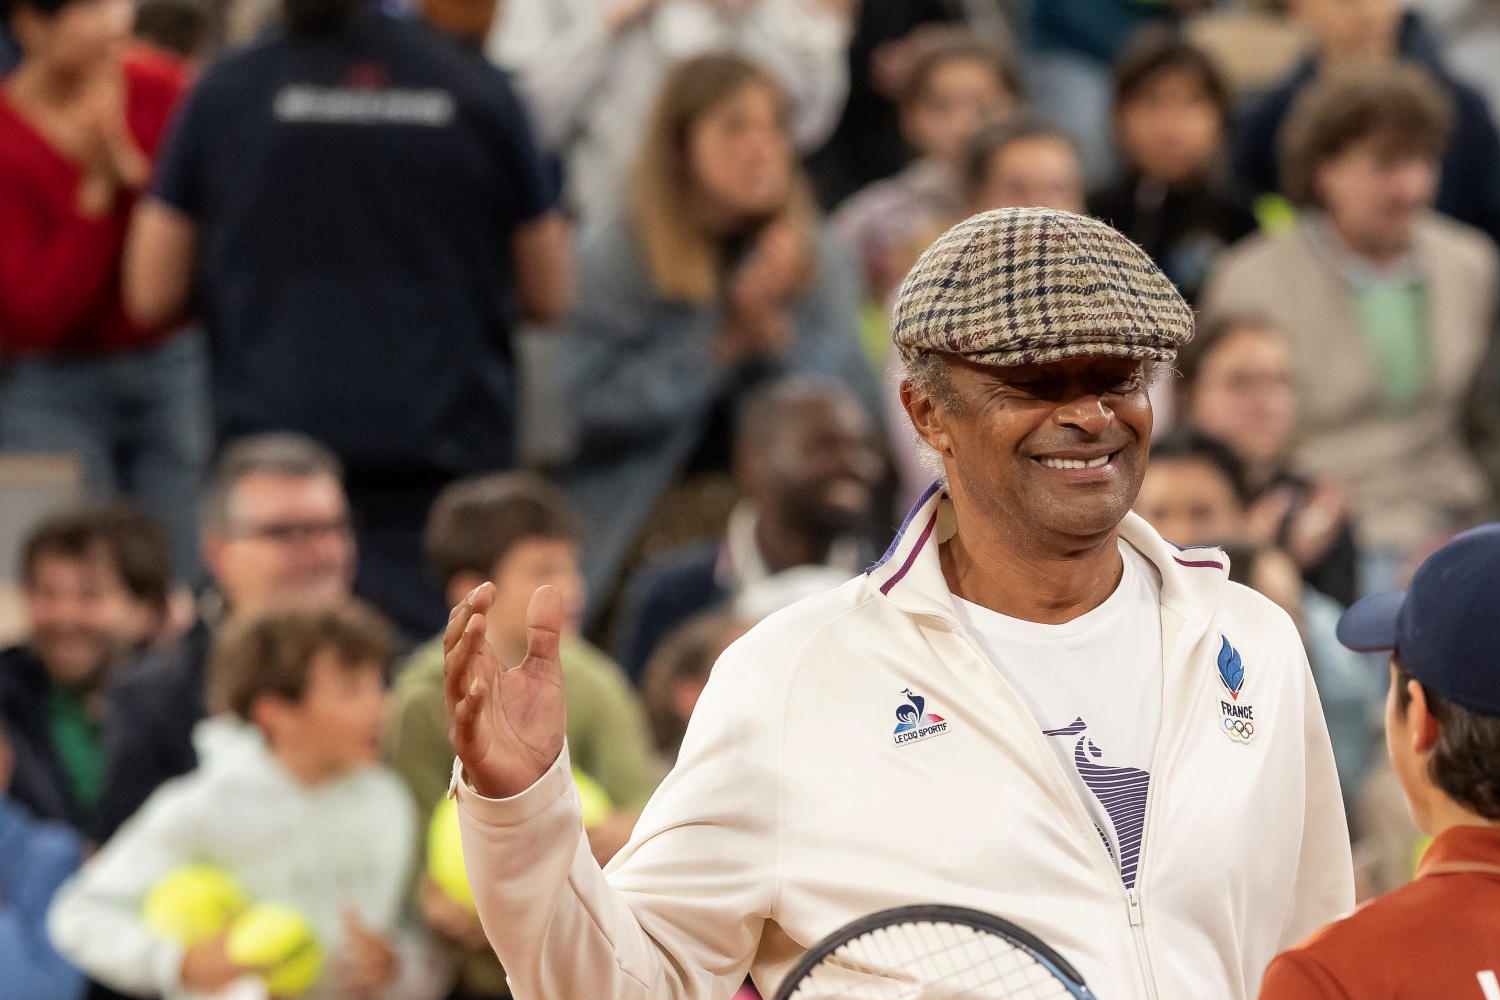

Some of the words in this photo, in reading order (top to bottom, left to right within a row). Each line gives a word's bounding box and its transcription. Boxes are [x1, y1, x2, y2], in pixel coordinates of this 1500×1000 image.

[1220, 700, 1254, 720] FRANCE
[893, 733, 903, 744] LE
[903, 730, 918, 742] COQ
[919, 722, 947, 737] SPORTIF
